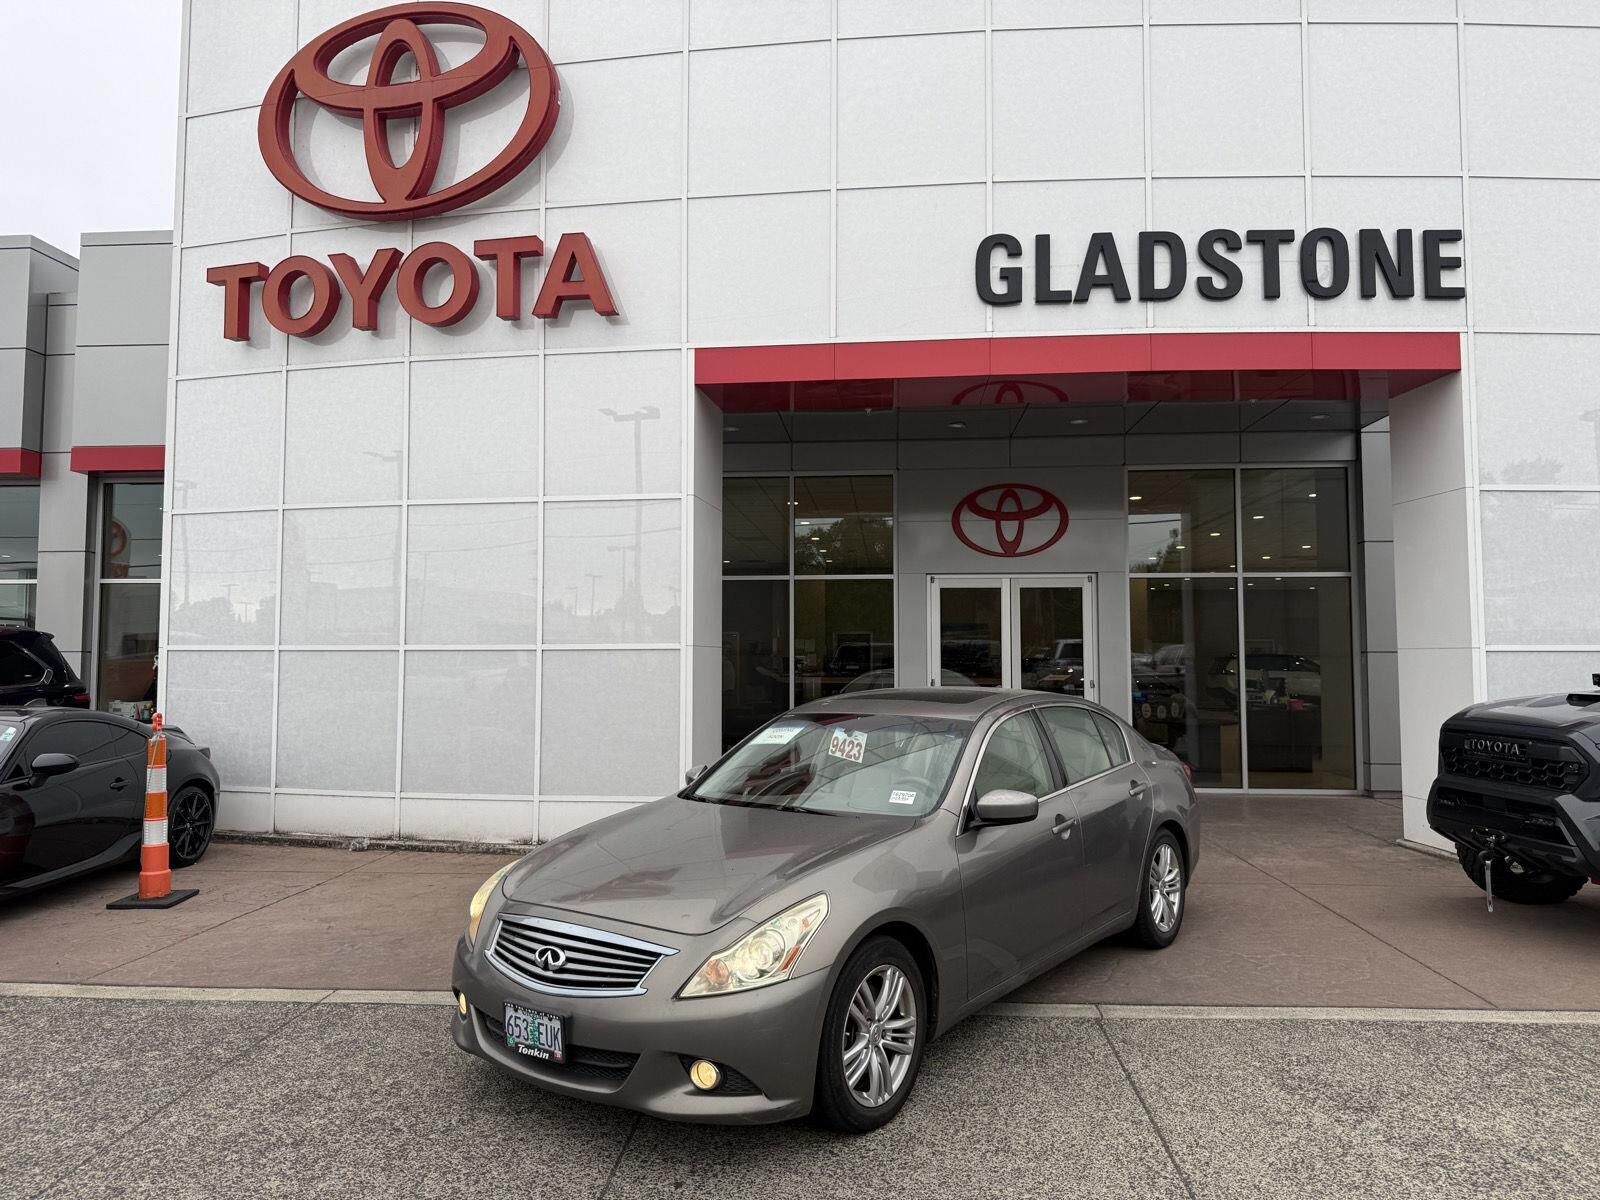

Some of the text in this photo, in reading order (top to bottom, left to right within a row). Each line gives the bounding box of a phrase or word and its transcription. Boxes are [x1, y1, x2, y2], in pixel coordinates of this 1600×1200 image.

[975, 227, 1466, 305] GLADSTONE
[206, 232, 619, 341] TOYOTA
[831, 735, 863, 761] 9423
[1471, 738, 1520, 755] TOYOTA
[507, 1014, 561, 1052] 653 EUK
[517, 1043, 550, 1060] Tonkin
